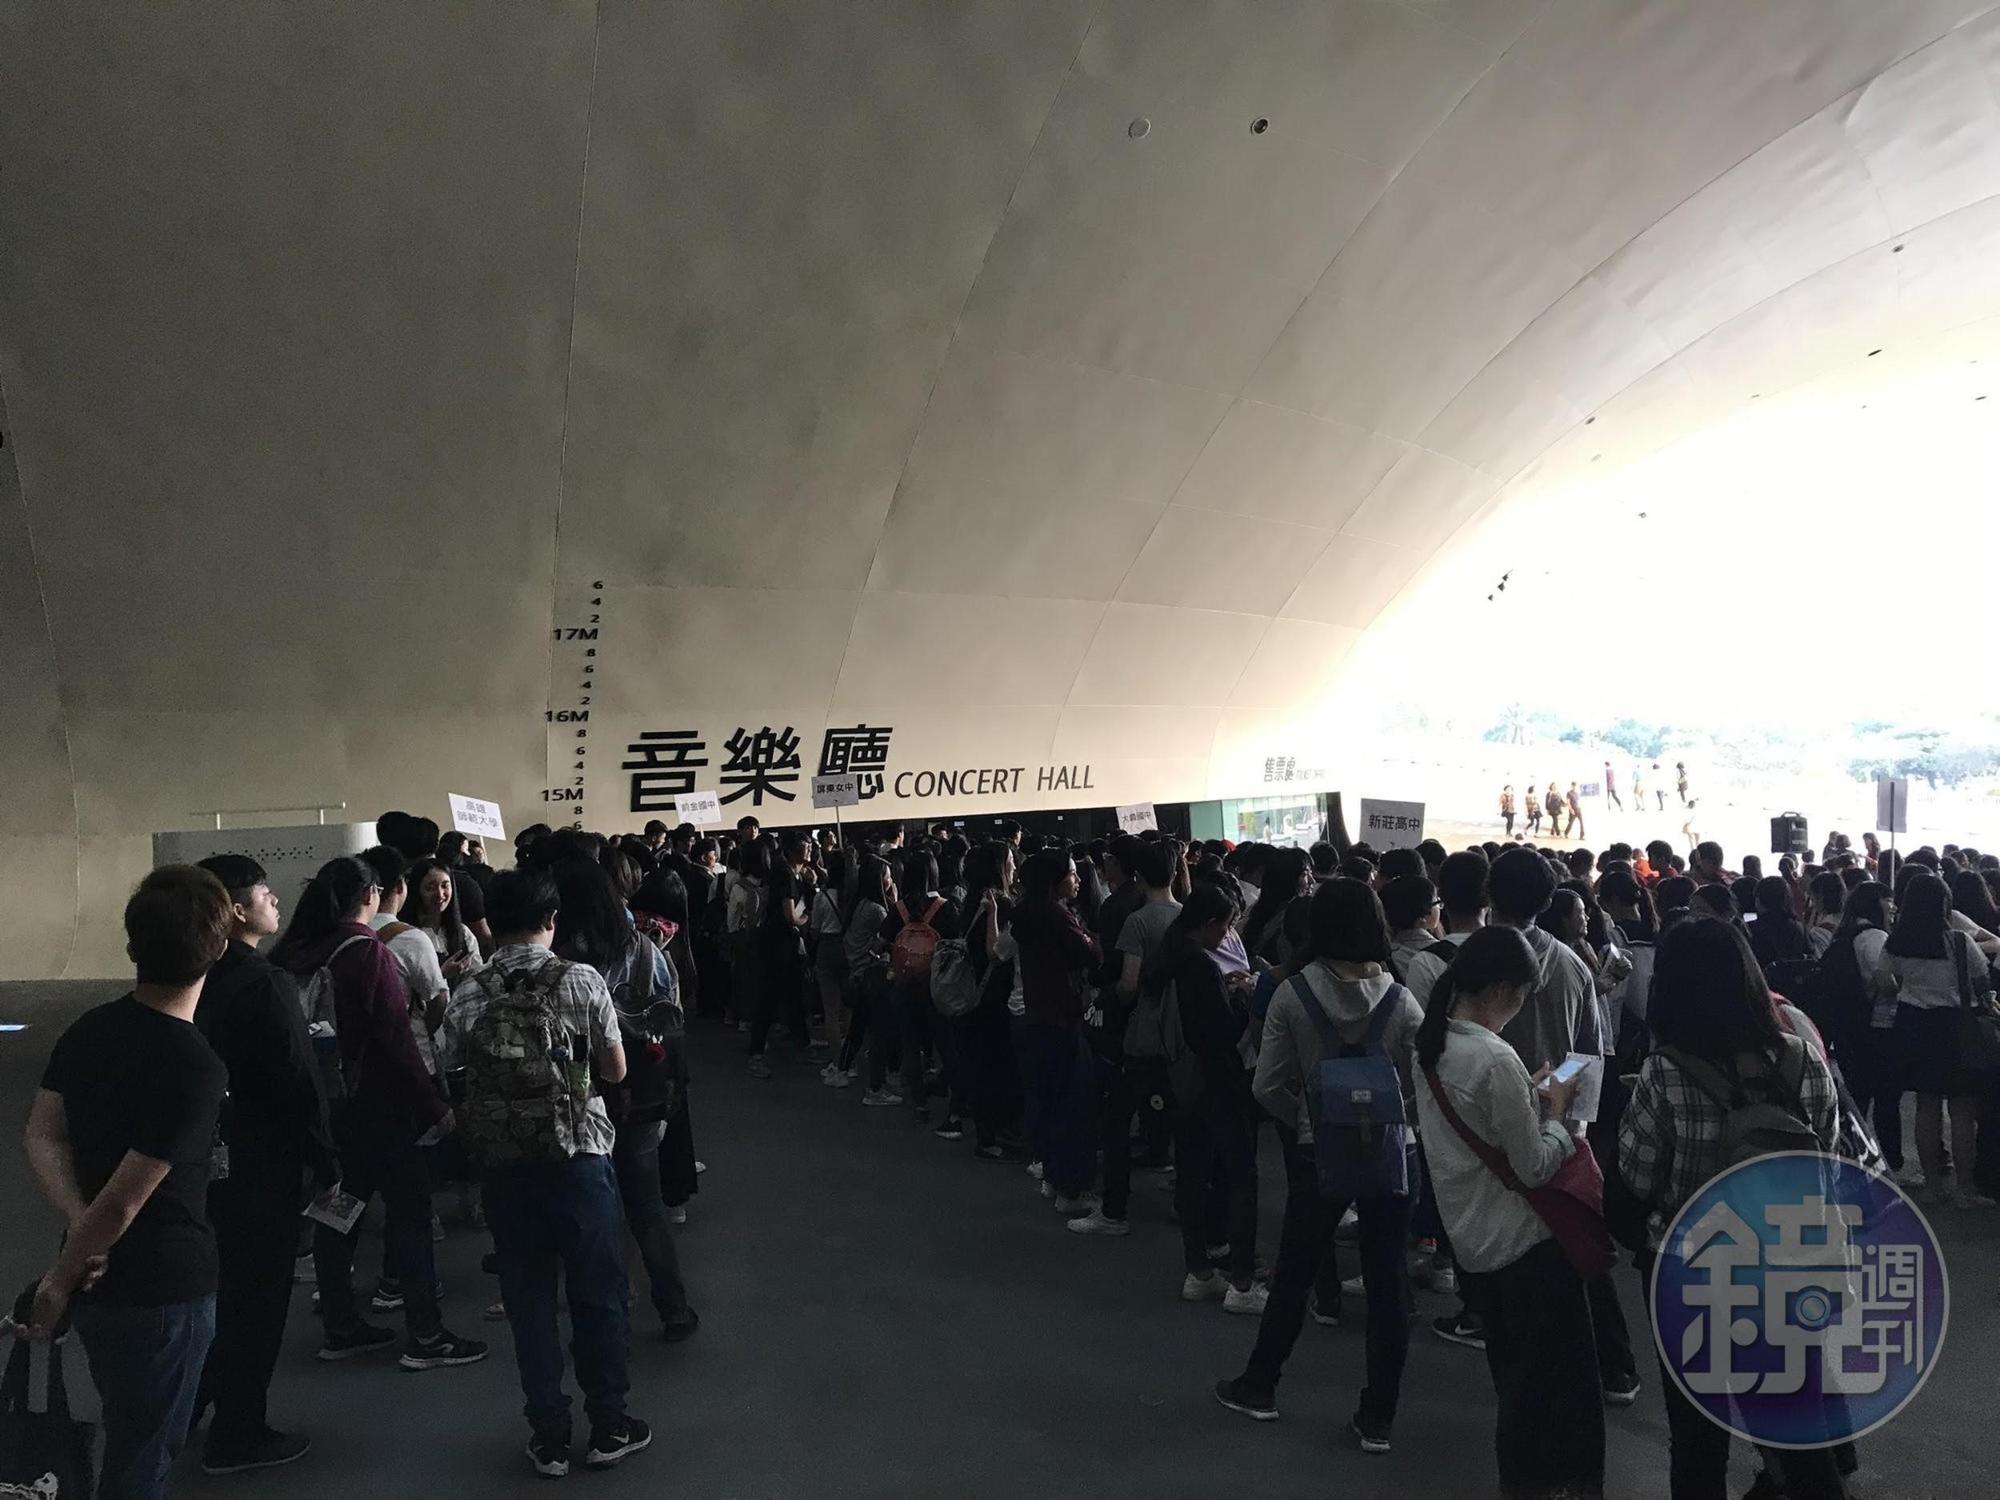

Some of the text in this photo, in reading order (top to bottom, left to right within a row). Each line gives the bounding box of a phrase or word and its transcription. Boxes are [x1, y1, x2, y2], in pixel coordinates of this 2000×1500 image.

[593, 580, 603, 590] 6
[591, 597, 601, 606] 4
[590, 614, 600, 623] 2
[553, 628, 599, 641] 17M
[586, 648, 596, 657] 8
[584, 665, 594, 674] 6
[582, 681, 592, 689] 4
[580, 696, 590, 705] 2
[544, 710, 589, 722] 16M
[576, 729, 587, 738] 8
[576, 746, 586, 756] 6
[574, 761, 584, 770] 4
[621, 723, 894, 813] 音樂廳
[575, 776, 584, 785] 2
[894, 764, 1095, 799] CONCERT HALL
[541, 788, 584, 802] 15M
[573, 806, 583, 815] 8
